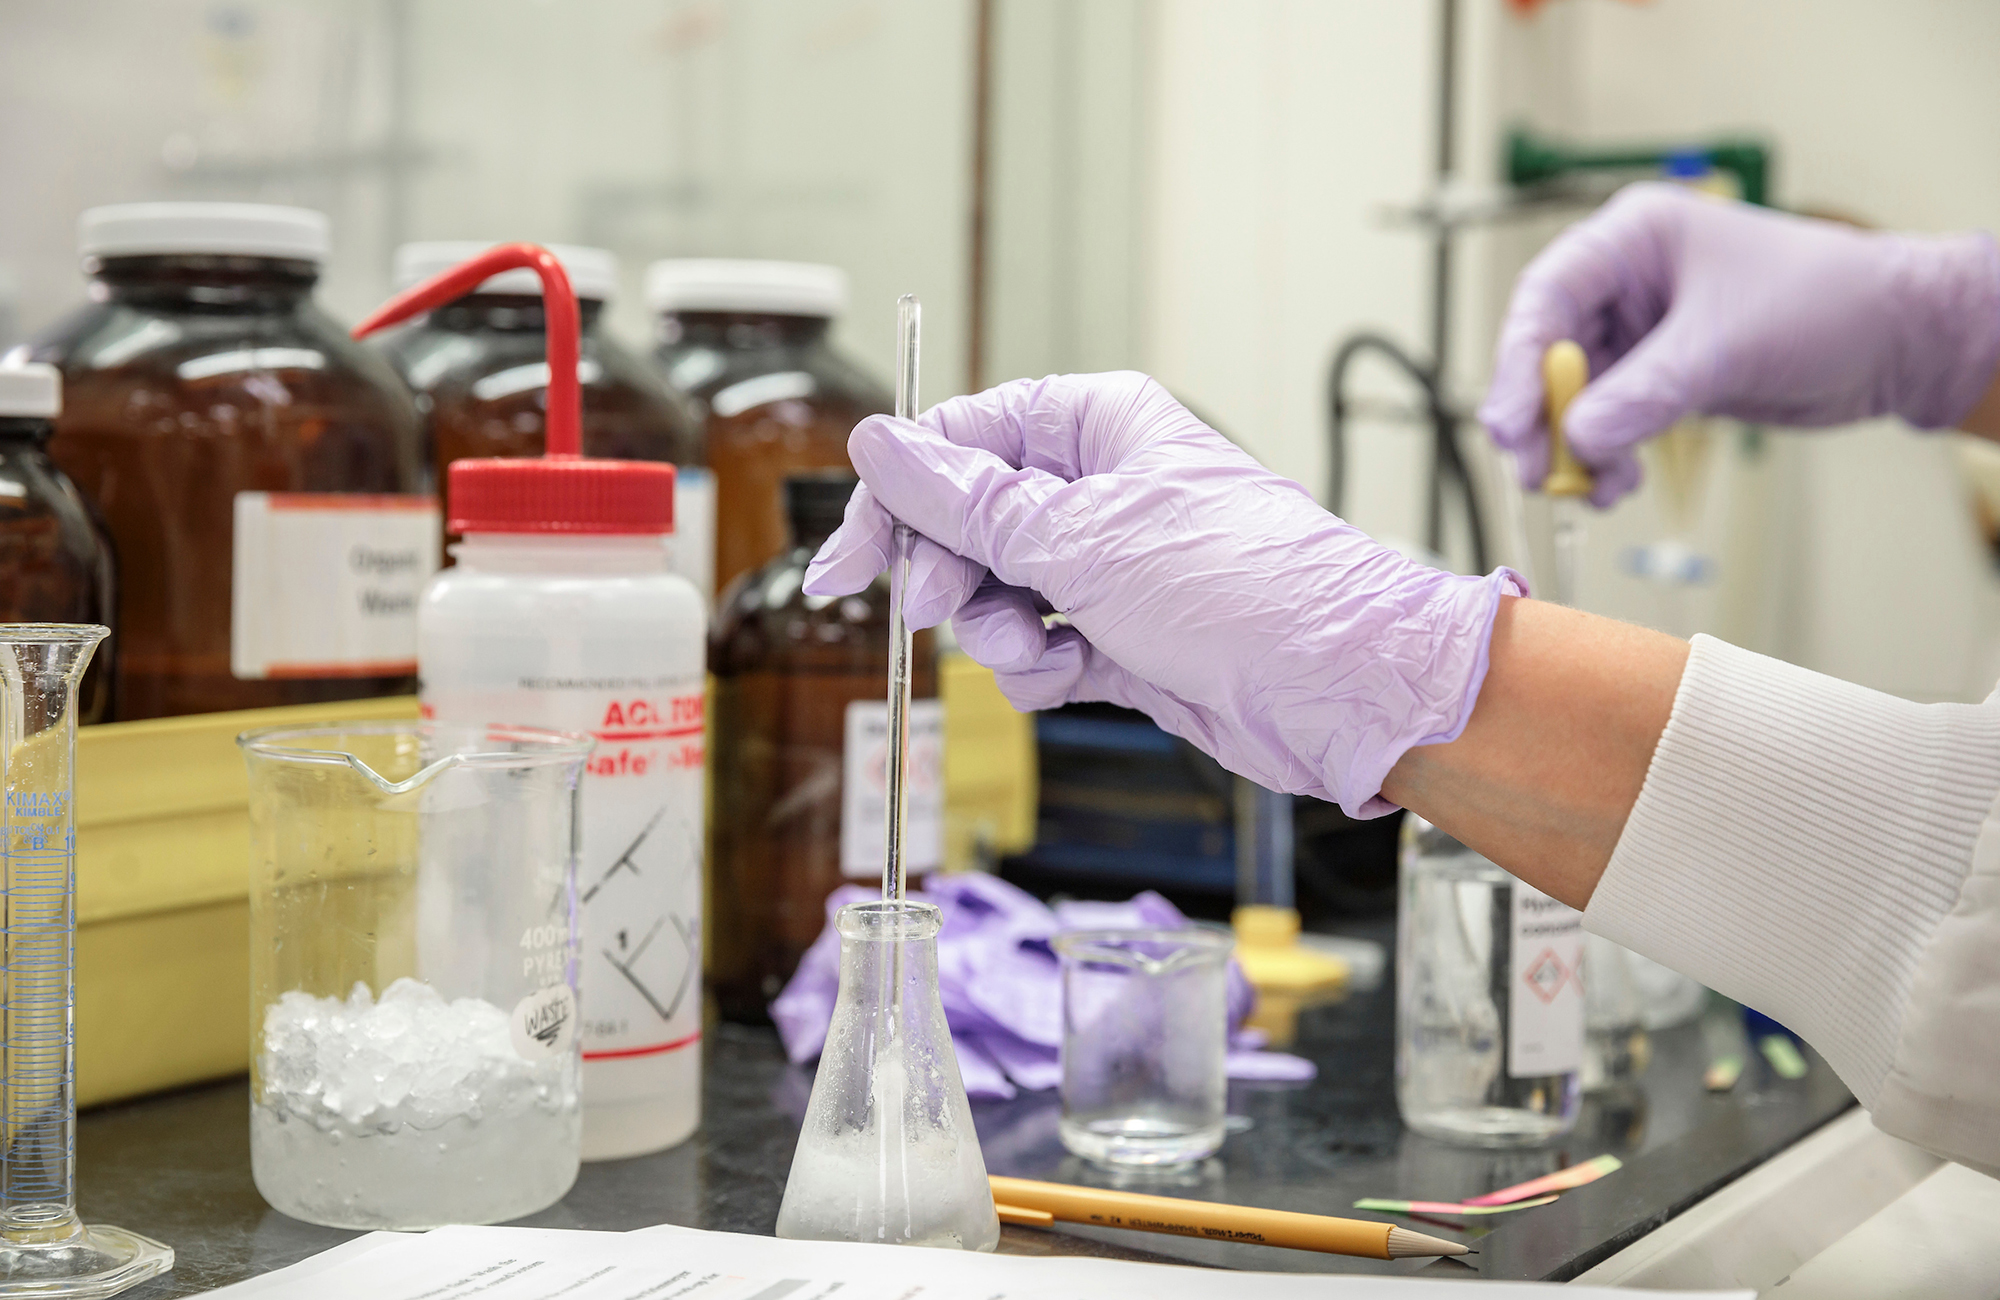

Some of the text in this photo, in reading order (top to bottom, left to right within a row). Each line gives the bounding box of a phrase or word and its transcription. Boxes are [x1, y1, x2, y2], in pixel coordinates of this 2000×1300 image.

[15, 806, 61, 817] KIMBLE
[32, 836, 44, 850] B
[64, 834, 76, 850] 10
